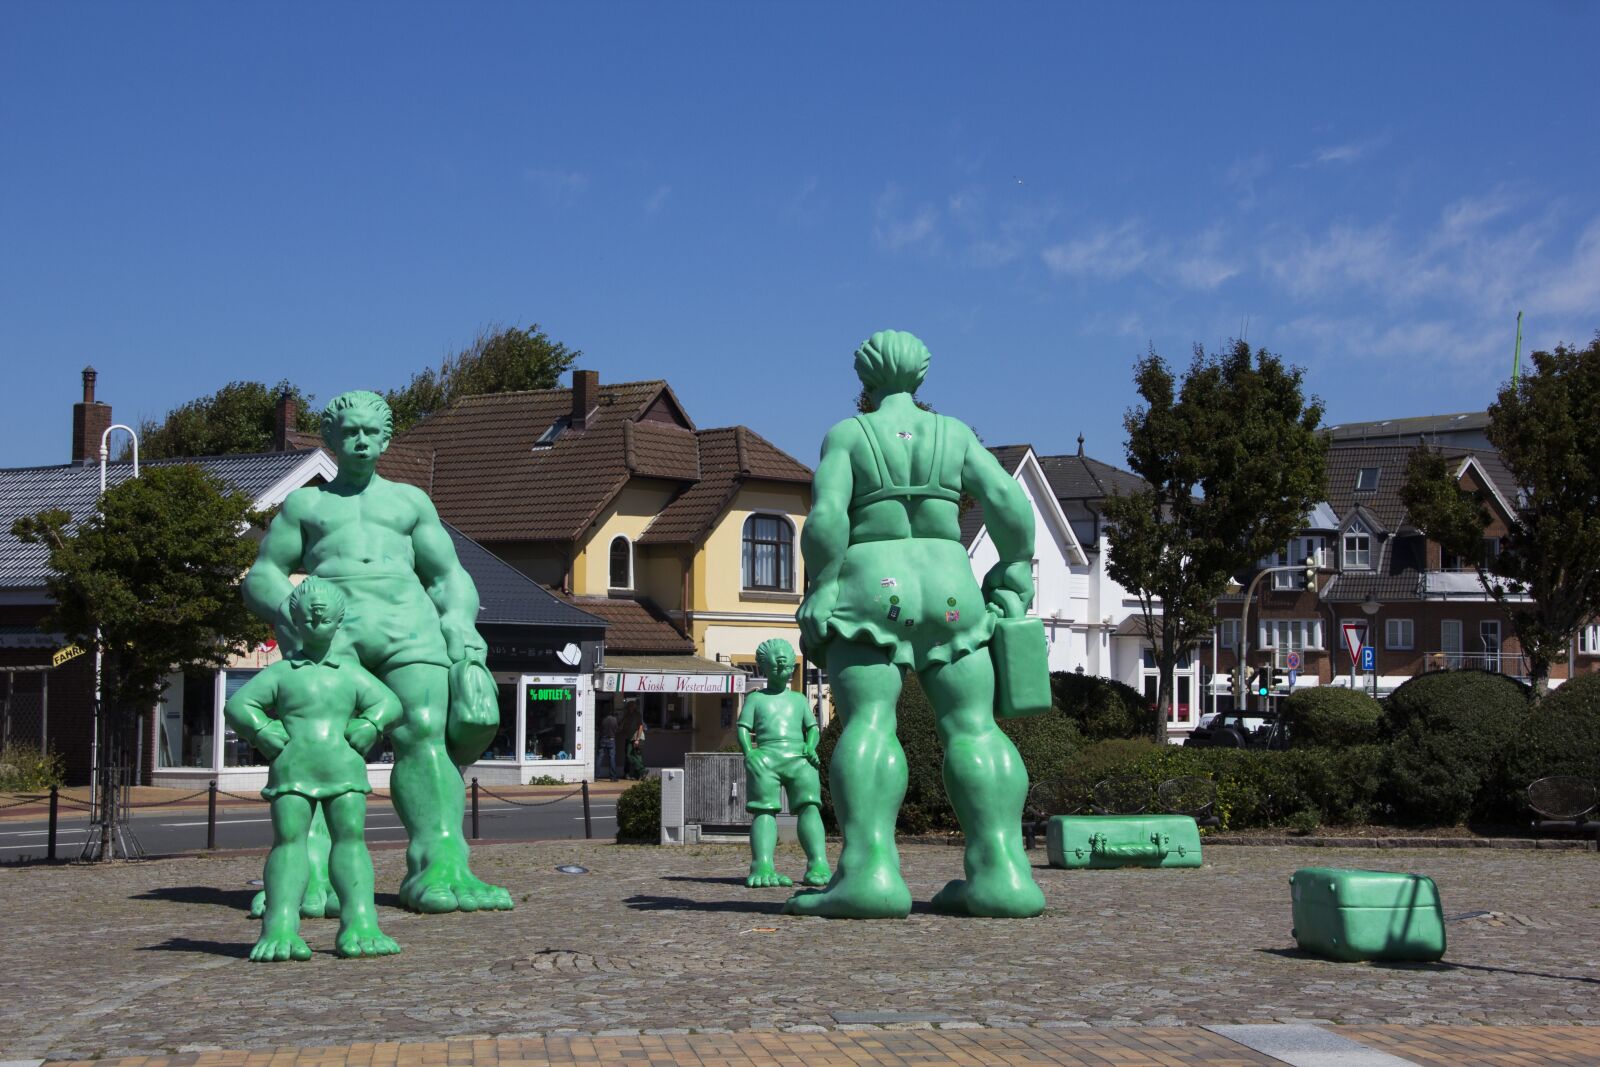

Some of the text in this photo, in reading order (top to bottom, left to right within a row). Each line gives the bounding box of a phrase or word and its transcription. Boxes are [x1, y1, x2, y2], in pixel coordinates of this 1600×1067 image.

[1365, 650, 1372, 667] P
[637, 675, 665, 691] Kiosk
[676, 676, 723, 691] Westerland
[538, 689, 563, 700] OUTLET
